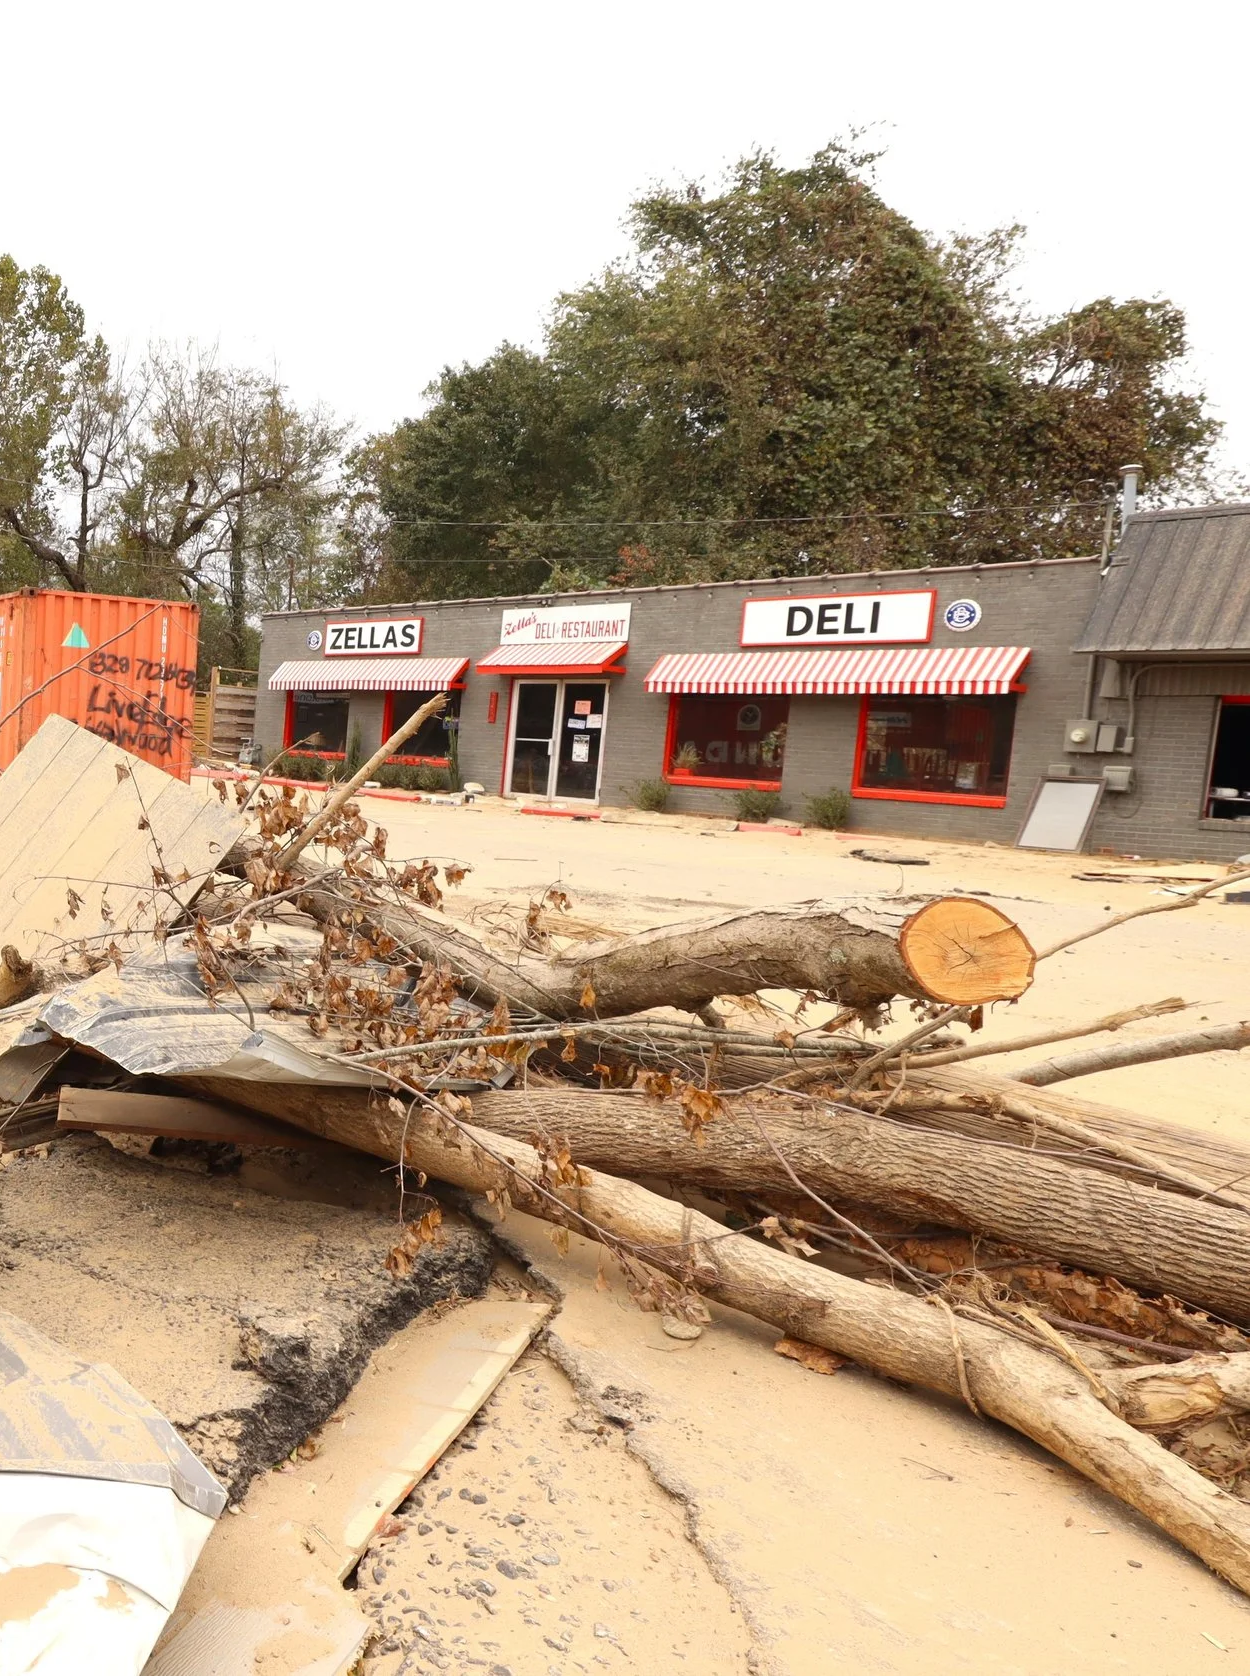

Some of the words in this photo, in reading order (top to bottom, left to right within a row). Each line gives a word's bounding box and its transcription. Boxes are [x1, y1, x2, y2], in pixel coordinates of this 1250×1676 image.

[534, 622, 556, 639] DELI
[561, 619, 626, 639] RESTAURANT
[785, 601, 881, 637] DELI
[329, 623, 416, 650] ZELLAS
